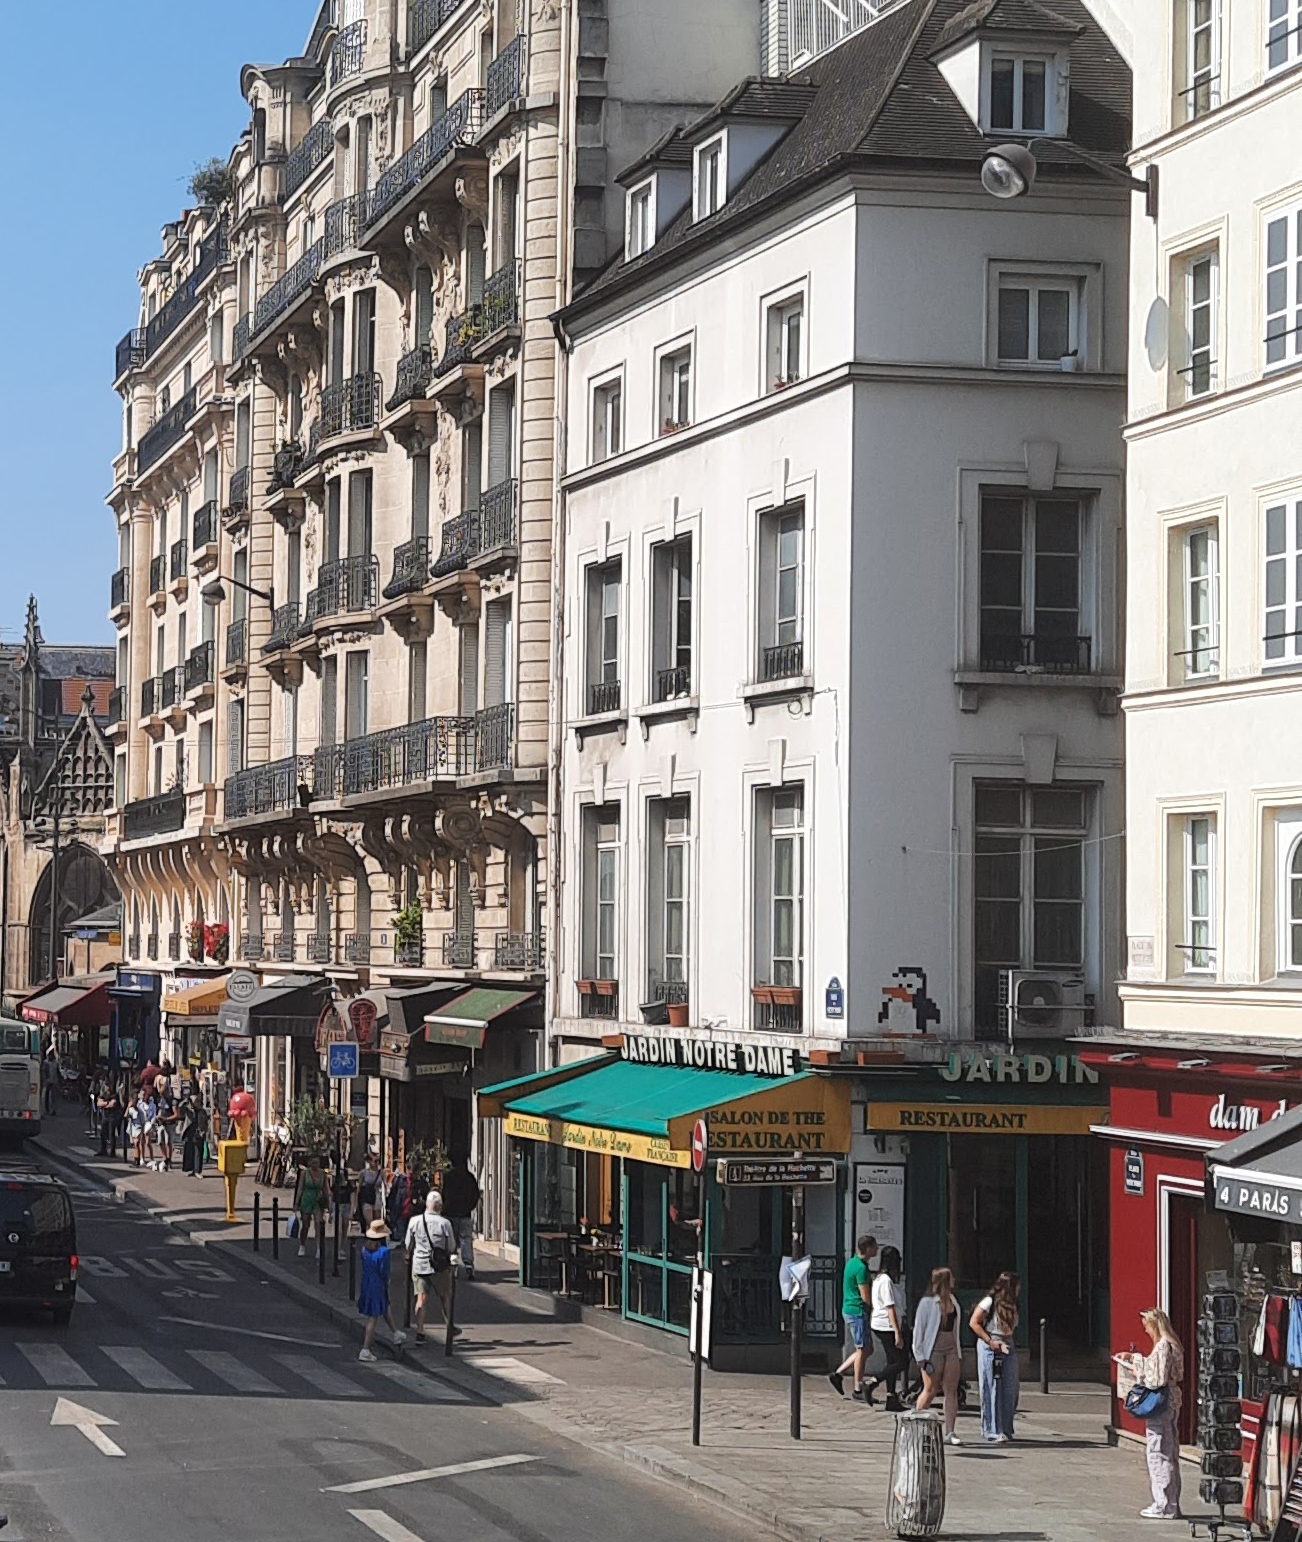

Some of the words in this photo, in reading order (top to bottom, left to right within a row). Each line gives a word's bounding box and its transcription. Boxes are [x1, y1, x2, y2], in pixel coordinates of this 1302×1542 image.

[621, 1034, 676, 1064] JARDIN
[681, 1040, 738, 1070] NOTRE
[745, 1046, 795, 1076] DAME
[940, 1052, 1099, 1084] JARDIN
[709, 1111, 761, 1126] SALON
[764, 1111, 790, 1126] DE
[795, 1111, 826, 1125] THE
[899, 1110, 1028, 1129] RESTAURANT
[1209, 1093, 1259, 1131] dam
[689, 1130, 826, 1150] ESTAURANT
[1220, 1186, 1229, 1204] 4
[1238, 1188, 1289, 1215] PARIS
[77, 1255, 238, 1282] BUS
